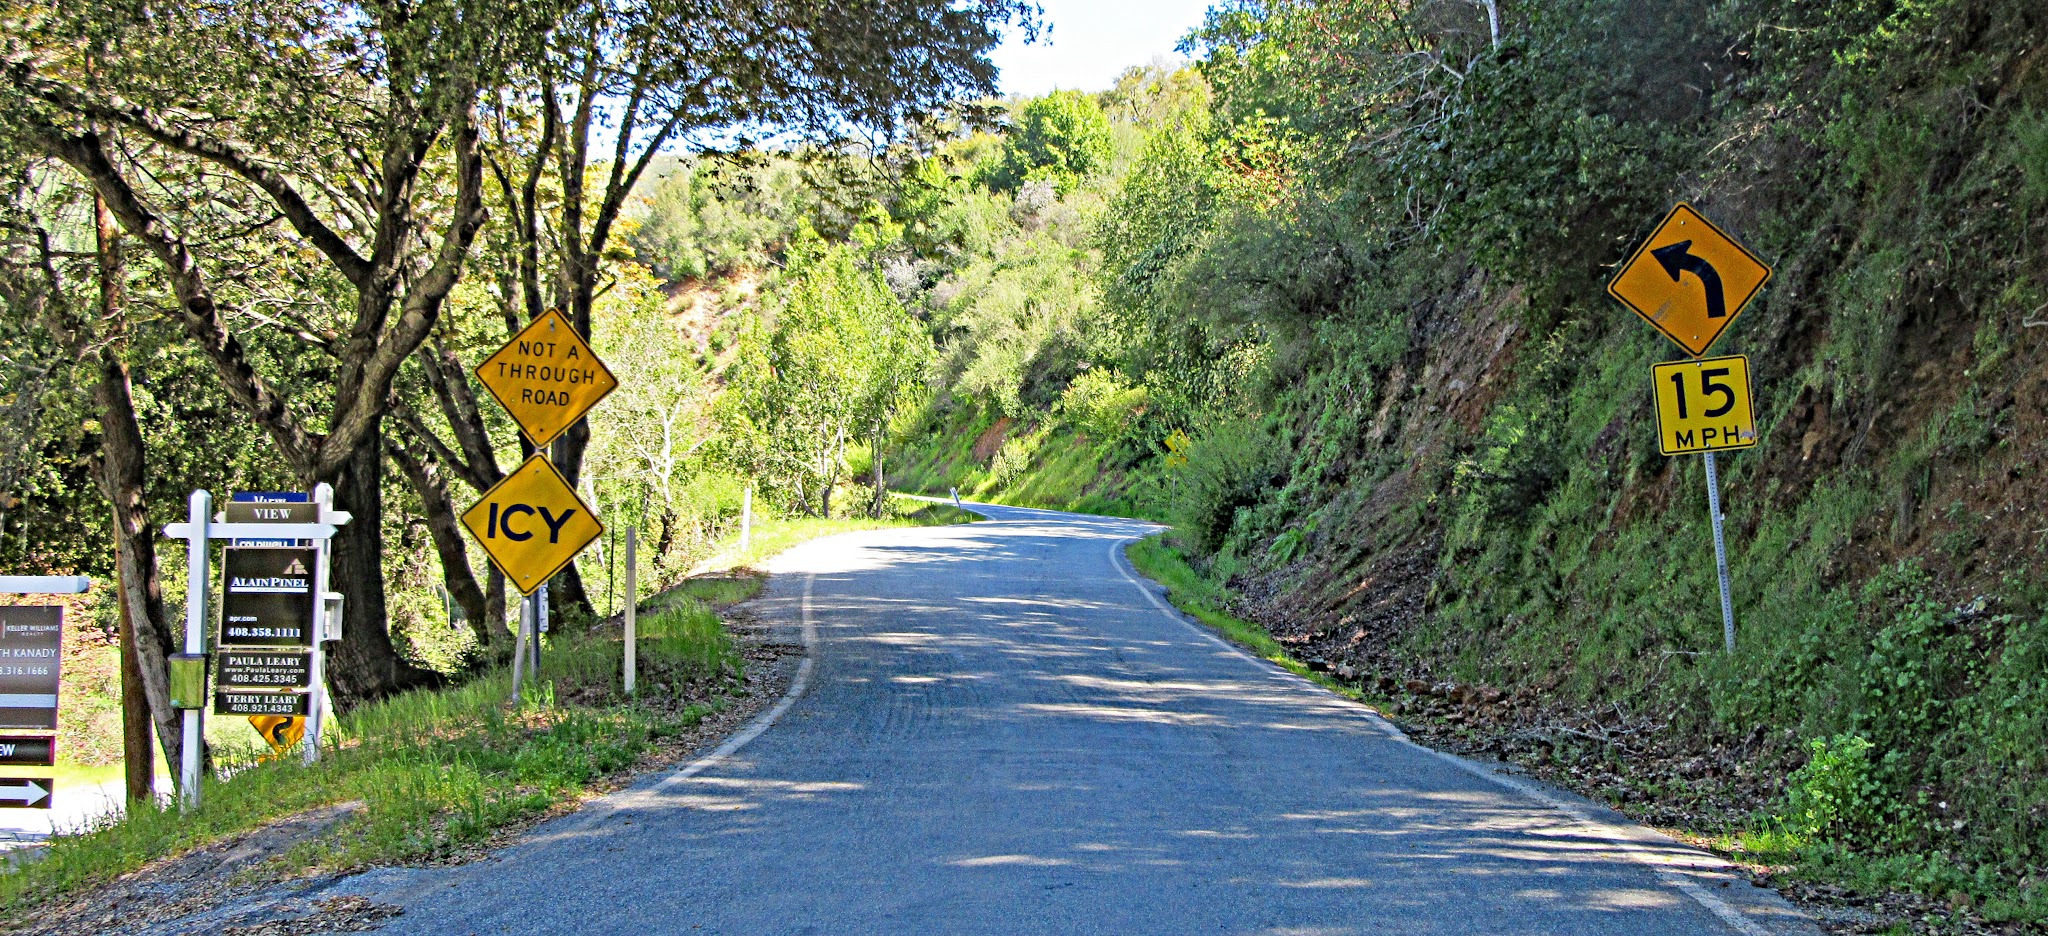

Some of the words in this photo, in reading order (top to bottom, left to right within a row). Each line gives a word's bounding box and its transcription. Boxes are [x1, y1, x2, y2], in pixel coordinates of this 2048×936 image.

[519, 340, 556, 358] NOT
[567, 345, 579, 360] A
[498, 362, 595, 385] THROUGH
[522, 388, 570, 406] ROAD
[1670, 367, 1735, 419] 15
[1675, 425, 1740, 449] MPH
[254, 508, 292, 519] VIEW
[487, 502, 577, 544] ICY
[231, 577, 270, 587] ALAIN
[270, 577, 309, 587] PINEL
[228, 627, 301, 637] 408.358.1111
[14, 649, 56, 657] KANADY
[229, 656, 263, 665] PAULA
[266, 657, 301, 666] LEARY
[231, 674, 297, 683] 408.425.3345
[226, 695, 261, 704] TERRY
[265, 695, 299, 704] LEARY
[231, 704, 293, 712] 408.921.4343
